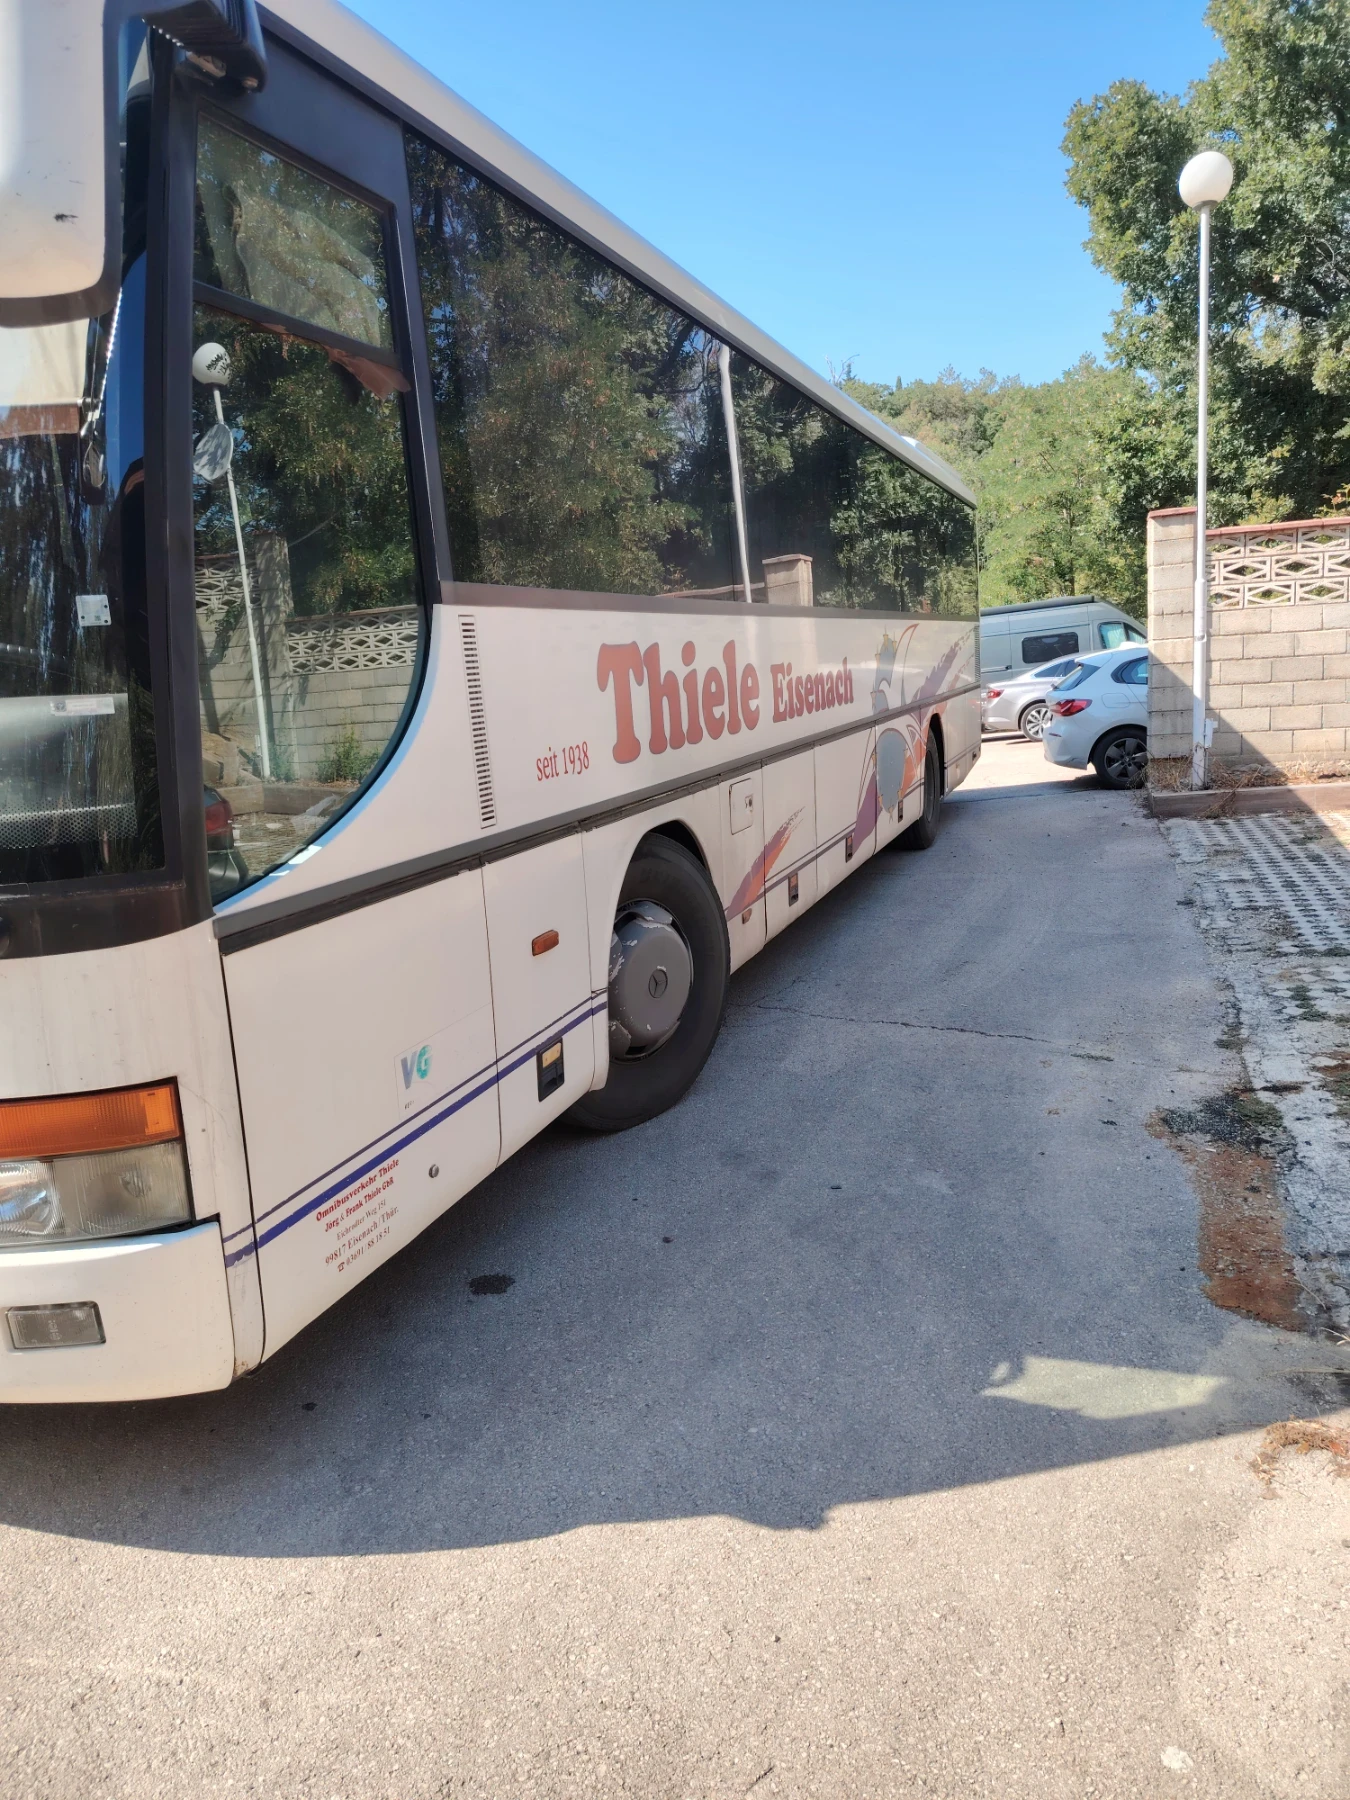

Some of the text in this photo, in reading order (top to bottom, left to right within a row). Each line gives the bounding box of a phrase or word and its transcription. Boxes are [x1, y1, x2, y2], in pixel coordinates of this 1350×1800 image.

[596, 639, 855, 765] Thiele Eisenach
[535, 741, 591, 782] seit 1938
[400, 1044, 433, 1090] VG
[316, 1159, 399, 1221] Omnibusverkehr Thiele
[325, 1176, 394, 1232] Jörg & Frank Thiele GbR
[365, 1207, 377, 1218] Weg
[325, 1243, 346, 1267] 99817
[347, 1220, 378, 1250] Eisenach
